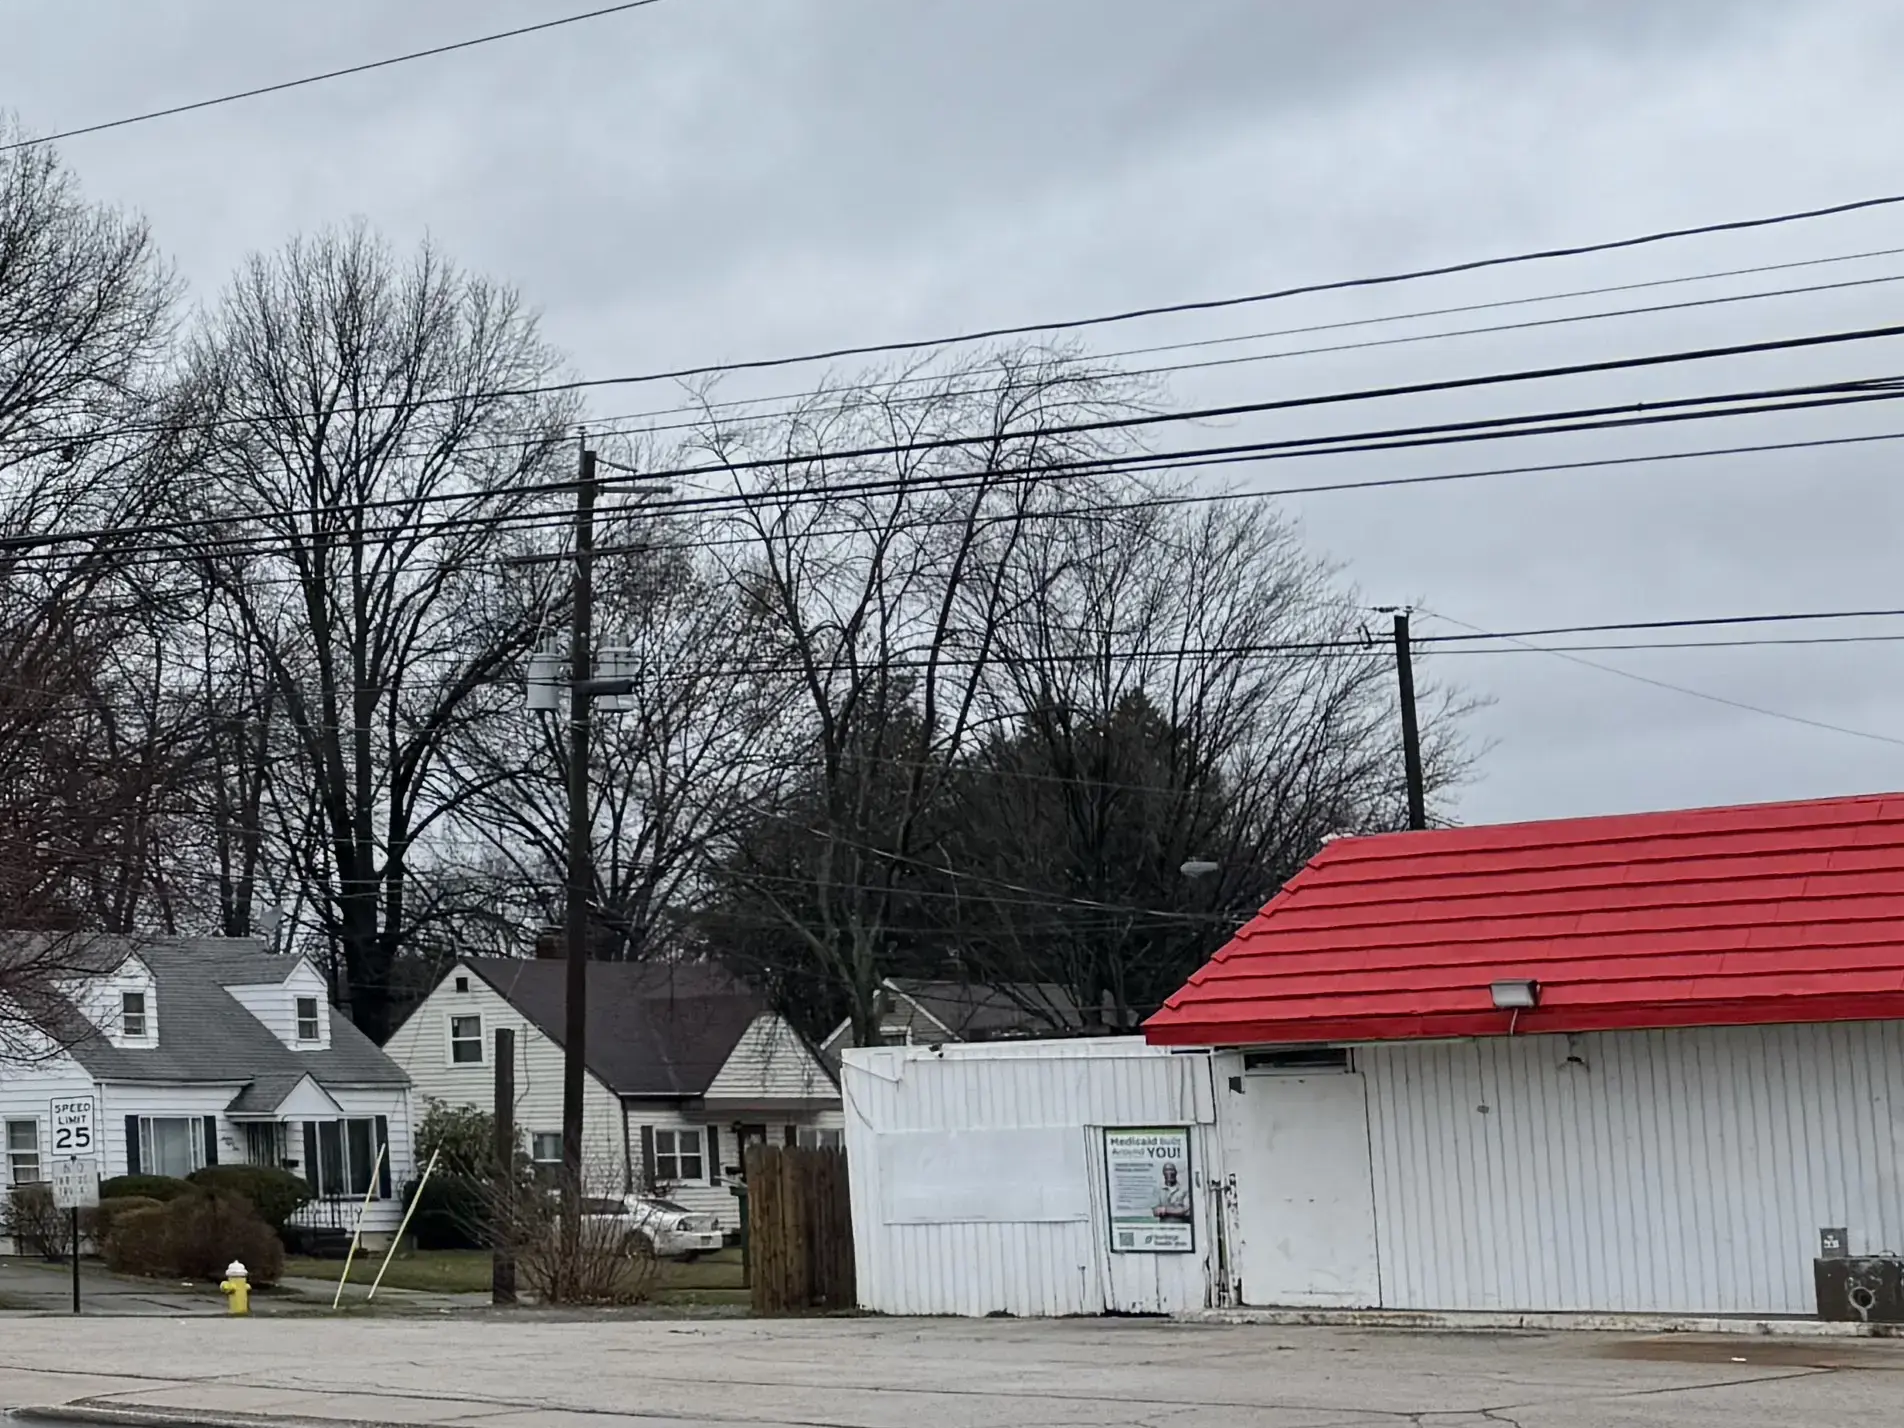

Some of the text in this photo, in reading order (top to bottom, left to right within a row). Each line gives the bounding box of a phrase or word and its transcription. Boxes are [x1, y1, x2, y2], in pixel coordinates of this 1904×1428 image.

[54, 1103, 91, 1114] SPEED
[58, 1115, 87, 1125] LIMIT
[56, 1127, 91, 1149] 25
[1147, 1147, 1181, 1159] YOU!
